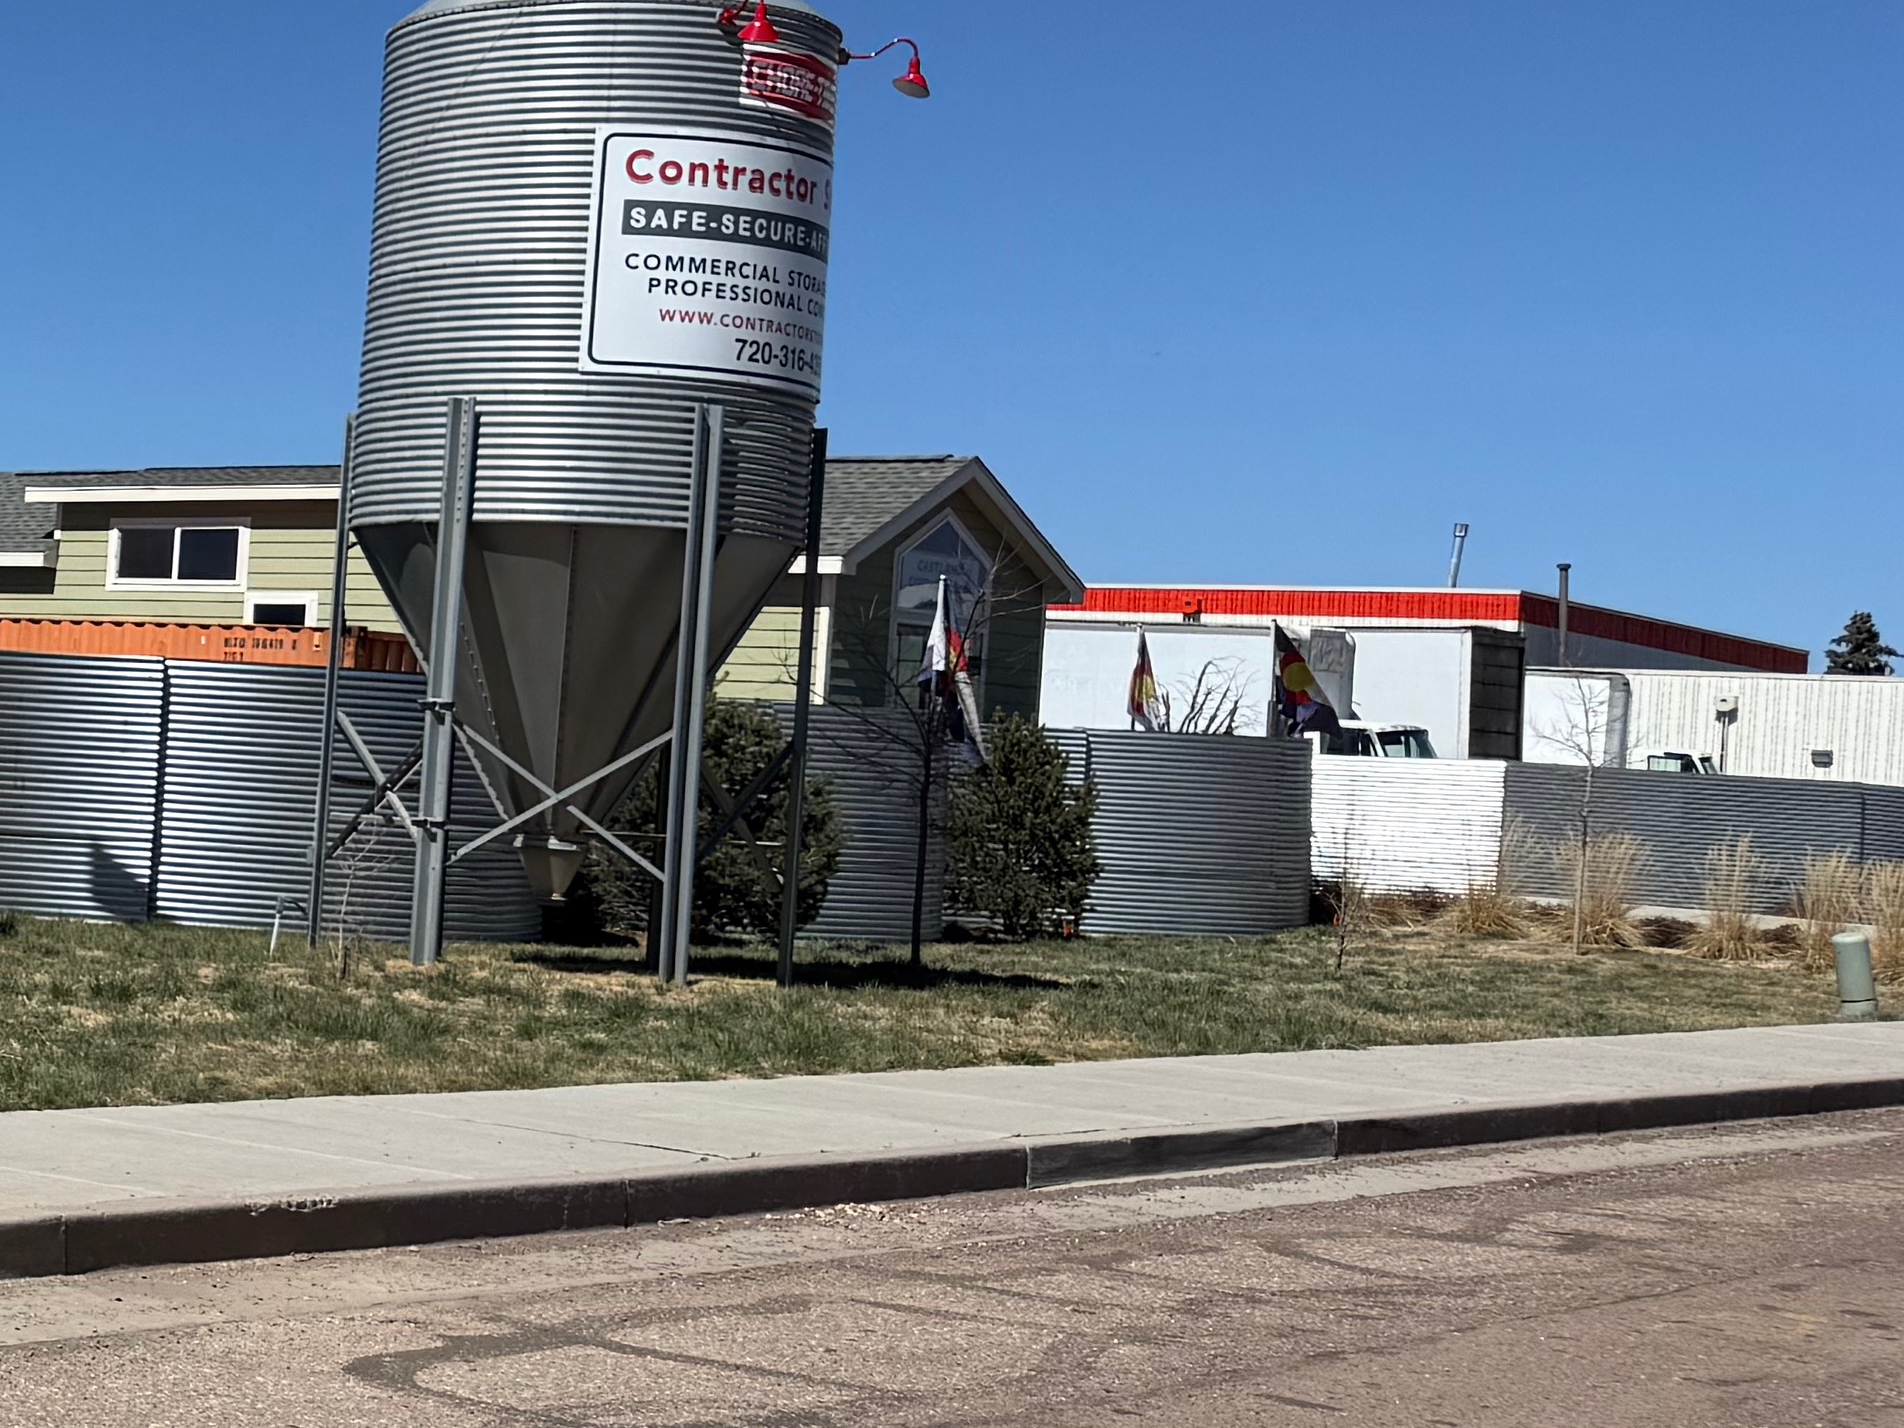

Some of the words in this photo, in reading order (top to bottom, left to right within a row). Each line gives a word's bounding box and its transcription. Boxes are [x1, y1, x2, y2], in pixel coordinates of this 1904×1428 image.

[626, 148, 818, 205] Contractor
[625, 253, 780, 284] COMMERCIAL
[648, 277, 803, 312] PROFESSIONAL
